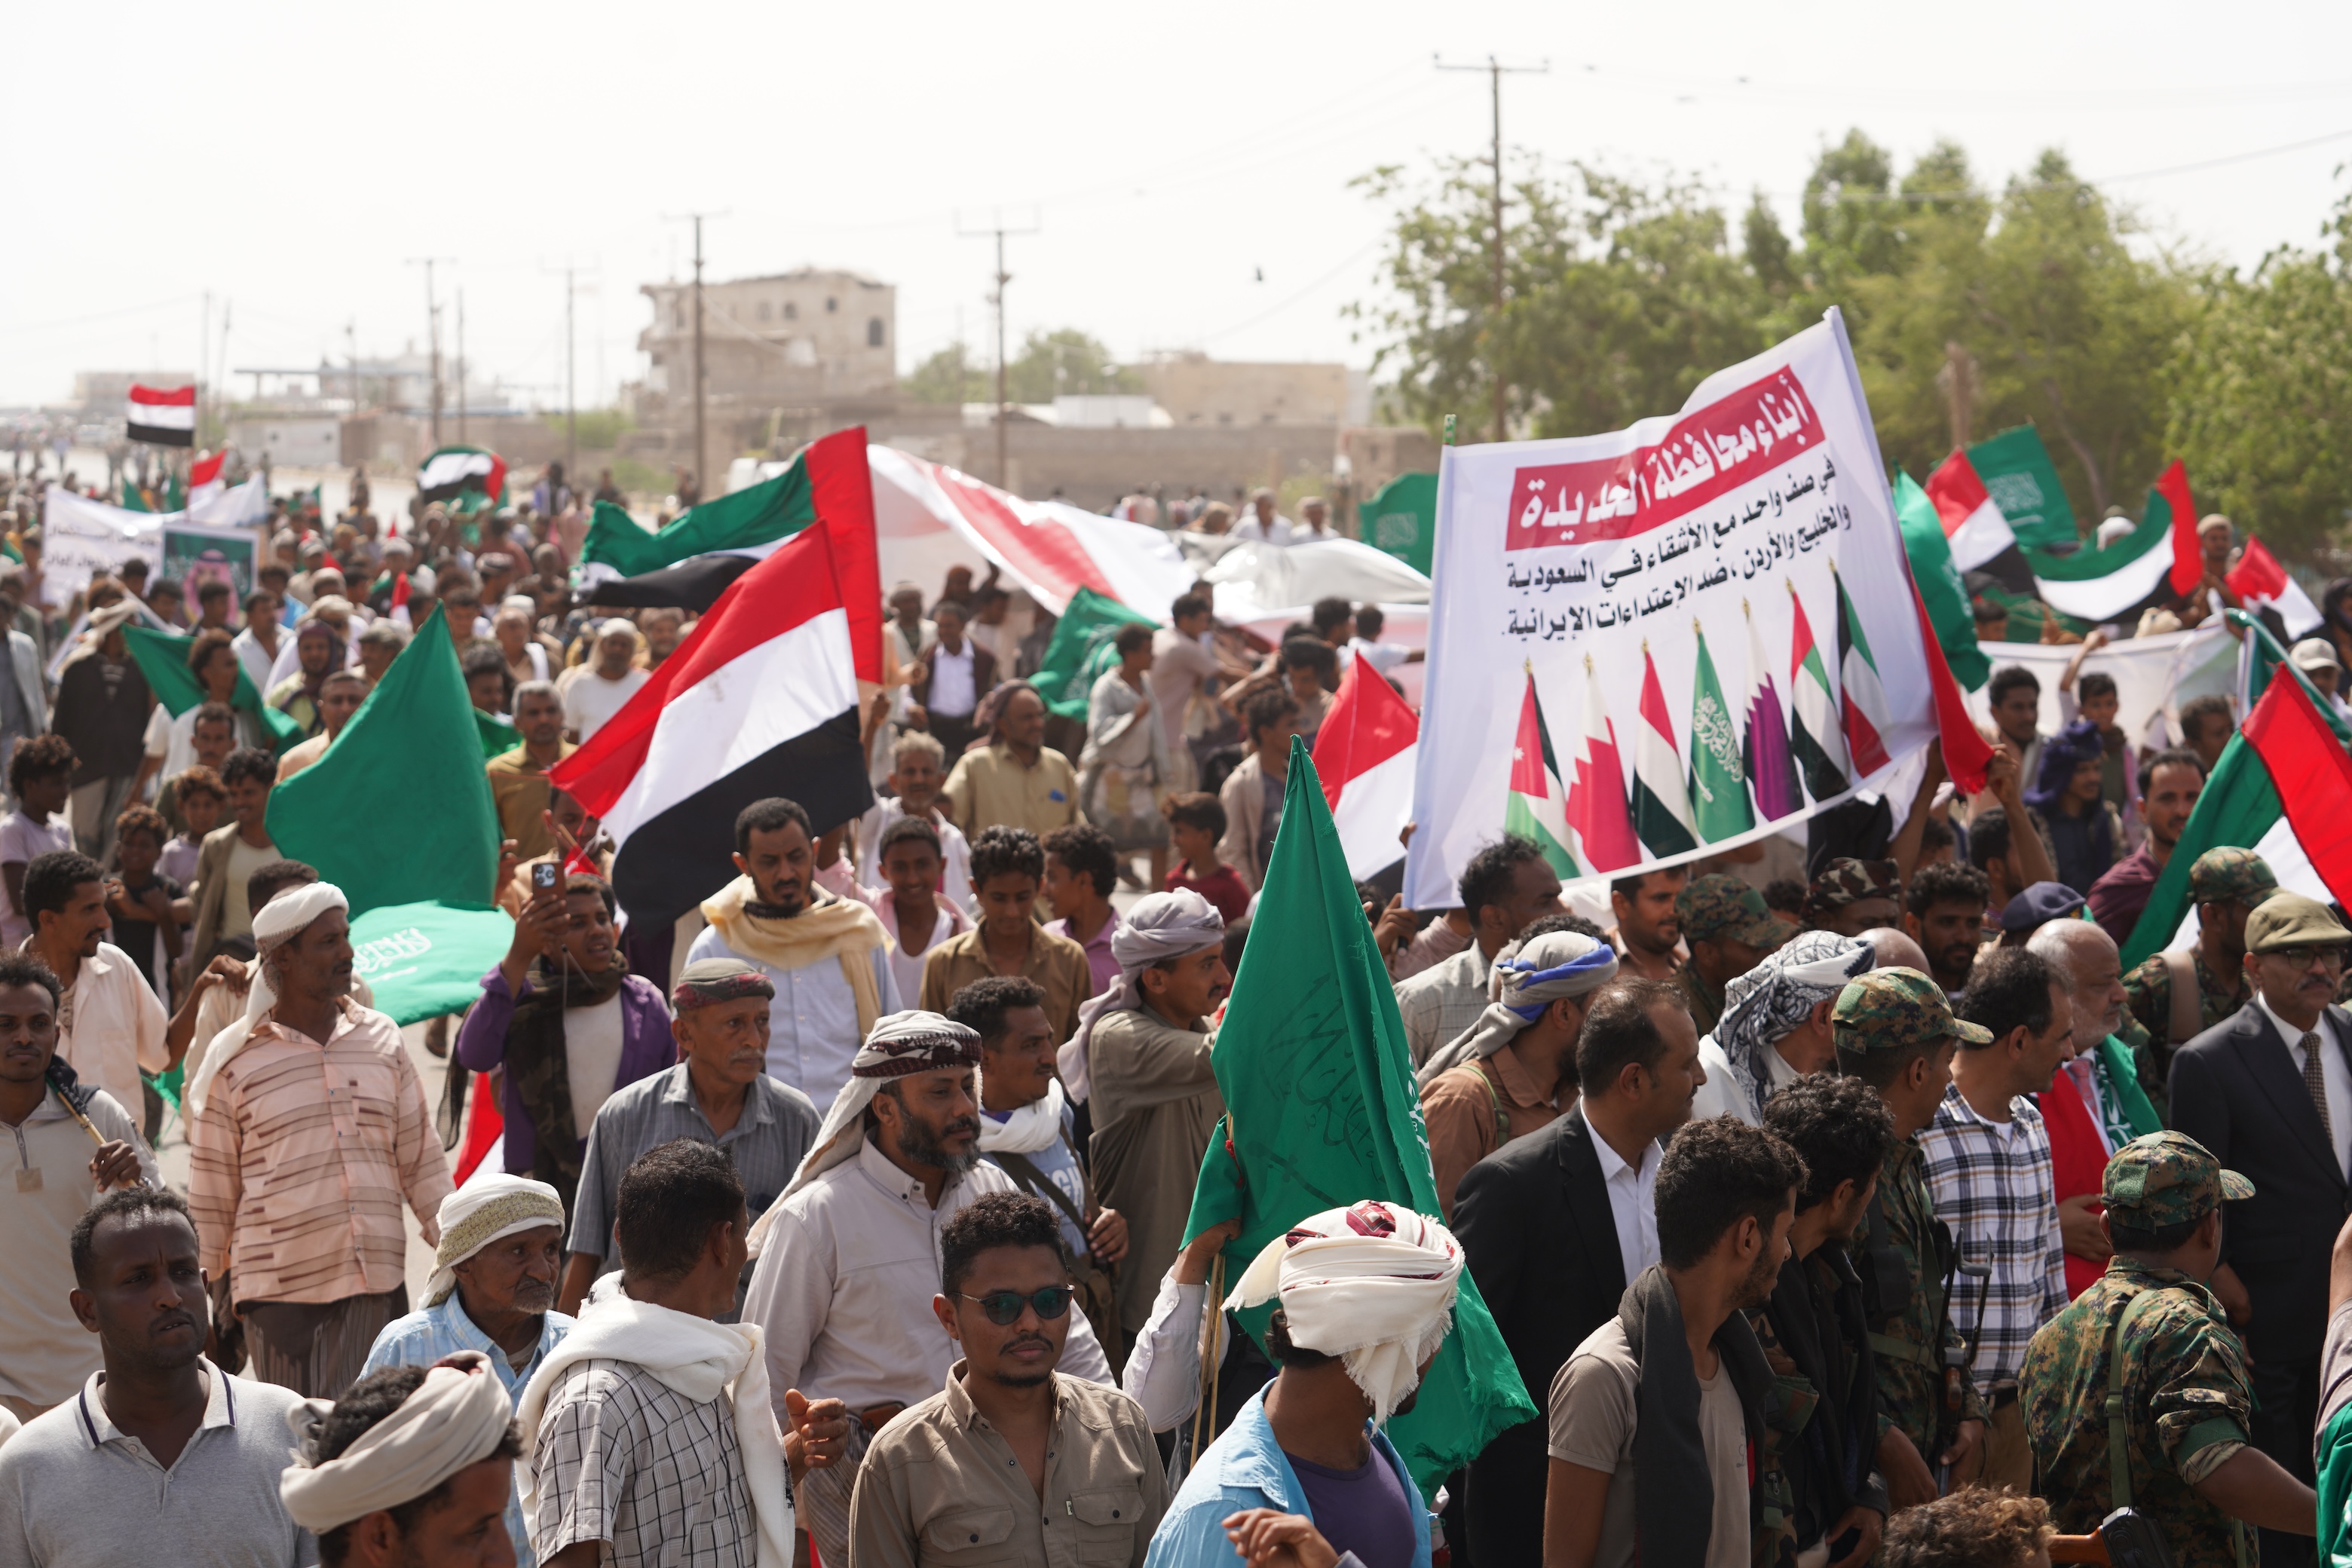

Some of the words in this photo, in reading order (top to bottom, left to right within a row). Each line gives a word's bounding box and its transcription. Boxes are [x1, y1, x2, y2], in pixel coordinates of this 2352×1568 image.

[1755, 374, 1809, 458] أبناء
[1646, 424, 1757, 501] محافظة
[1819, 453, 1836, 495] في
[1520, 467, 1650, 541] الحديدة
[1742, 488, 1782, 525] واحد
[1784, 473, 1815, 502] صف
[1647, 520, 1708, 572] الأشقاء
[1713, 513, 1736, 549] مع
[1797, 502, 1851, 553] والخليج
[1507, 556, 1594, 596] السعودية
[1601, 548, 1643, 593] في
